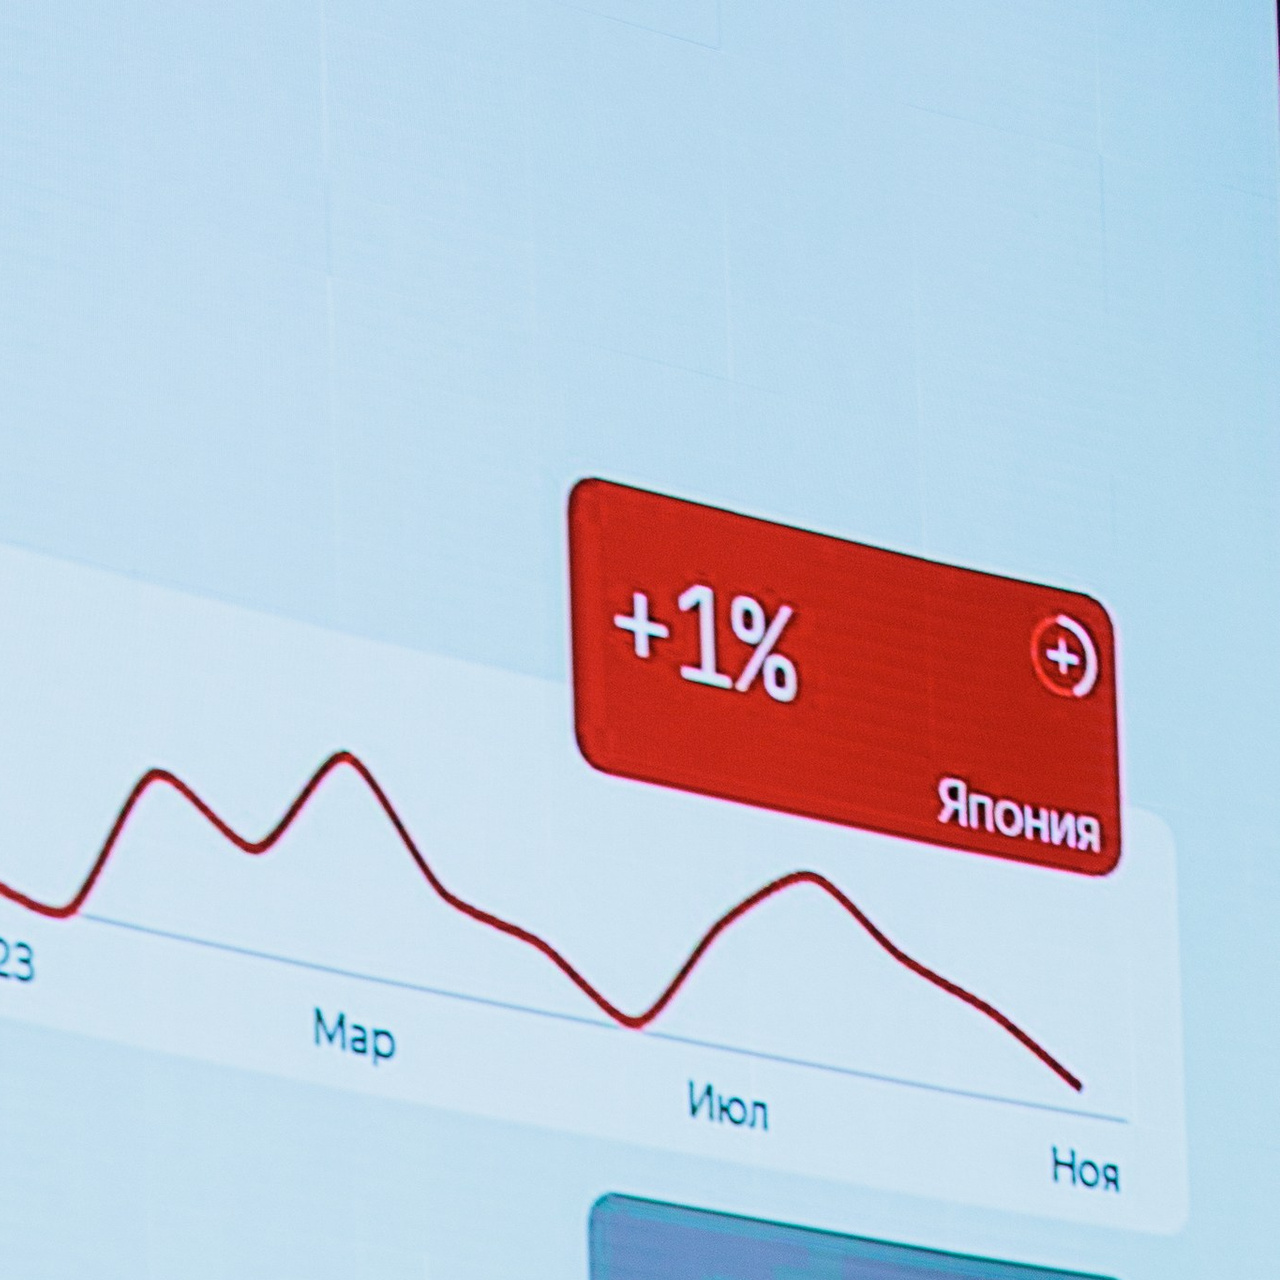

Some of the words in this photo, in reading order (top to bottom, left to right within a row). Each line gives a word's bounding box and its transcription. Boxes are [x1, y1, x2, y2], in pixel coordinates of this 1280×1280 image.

[613, 584, 799, 703] +1%
[937, 777, 1102, 853] Япония
[313, 1006, 396, 1066] Мар
[688, 1079, 770, 1132] Июл
[1051, 1145, 1120, 1193] Ноя
